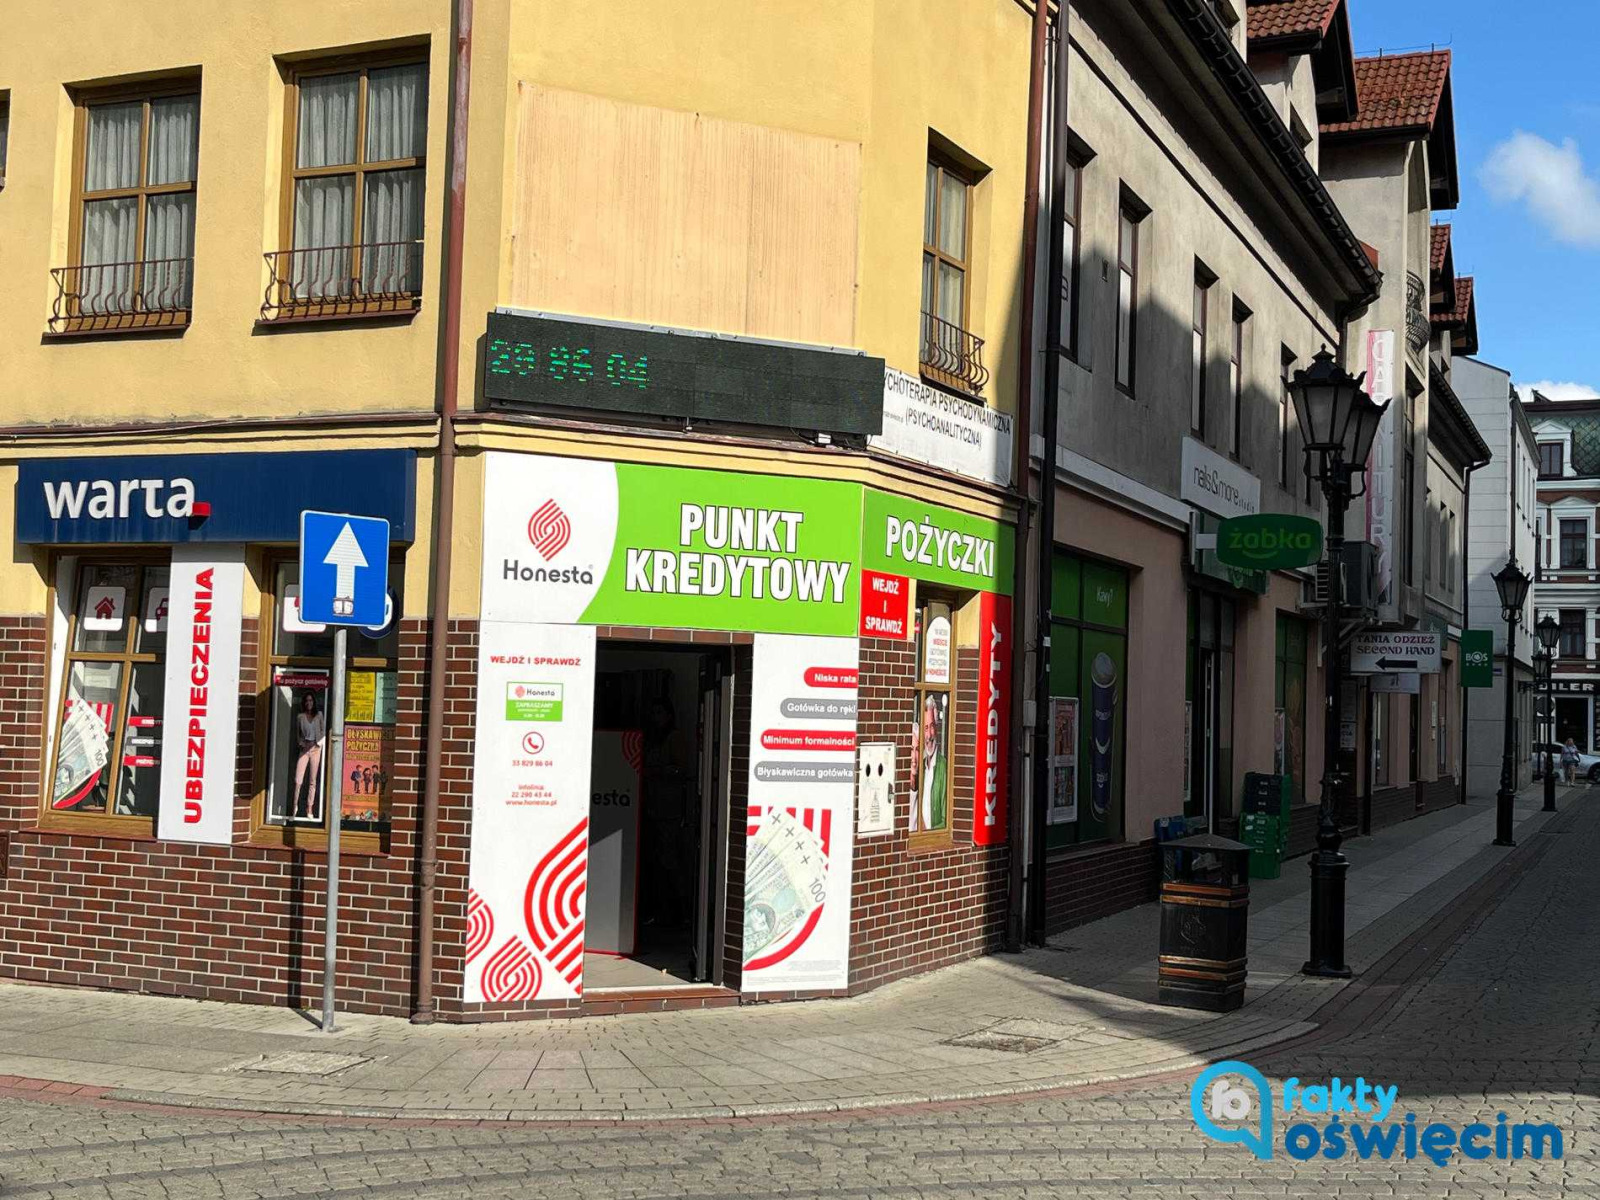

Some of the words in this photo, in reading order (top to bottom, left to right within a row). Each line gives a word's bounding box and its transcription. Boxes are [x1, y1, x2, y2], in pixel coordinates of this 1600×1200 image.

[938, 393, 1011, 435] PSYCHODYNAMICZNA
[905, 405, 982, 450] (PSYCHOANALITYCZNA)
[43, 478, 195, 519] warta
[679, 502, 804, 553] PUNKT
[885, 514, 996, 578] POŻYCZKI
[1228, 527, 1312, 549] żabka
[503, 558, 593, 585] Honesta
[625, 547, 851, 604] KREDYTOWY
[872, 576, 899, 595] WEJDŹ
[883, 600, 887, 613] I
[865, 615, 903, 634] SPRAWDŹ
[1357, 635, 1390, 644] TANIA
[490, 655, 525, 664] WEJDŹ
[527, 656, 531, 664] I
[534, 656, 581, 666] SPRAWDŹ
[1356, 646, 1402, 655] SECOND
[1405, 646, 1435, 656] HAND
[814, 673, 838, 683] Niska
[840, 674, 857, 684] rata
[184, 567, 214, 824] UBEZPIECZENIA
[526, 688, 555, 696] Honesta
[787, 702, 825, 712] Gotówka
[826, 703, 838, 713] do
[840, 703, 857, 715] ręki
[985, 620, 1001, 826] KREDYTY
[763, 735, 802, 745] Minimum
[805, 736, 855, 746] formalności
[757, 767, 815, 777] Błyskawiczna
[817, 768, 854, 778] gotówka
[505, 799, 557, 807] www.honesta.pl
[808, 877, 826, 904] 100
